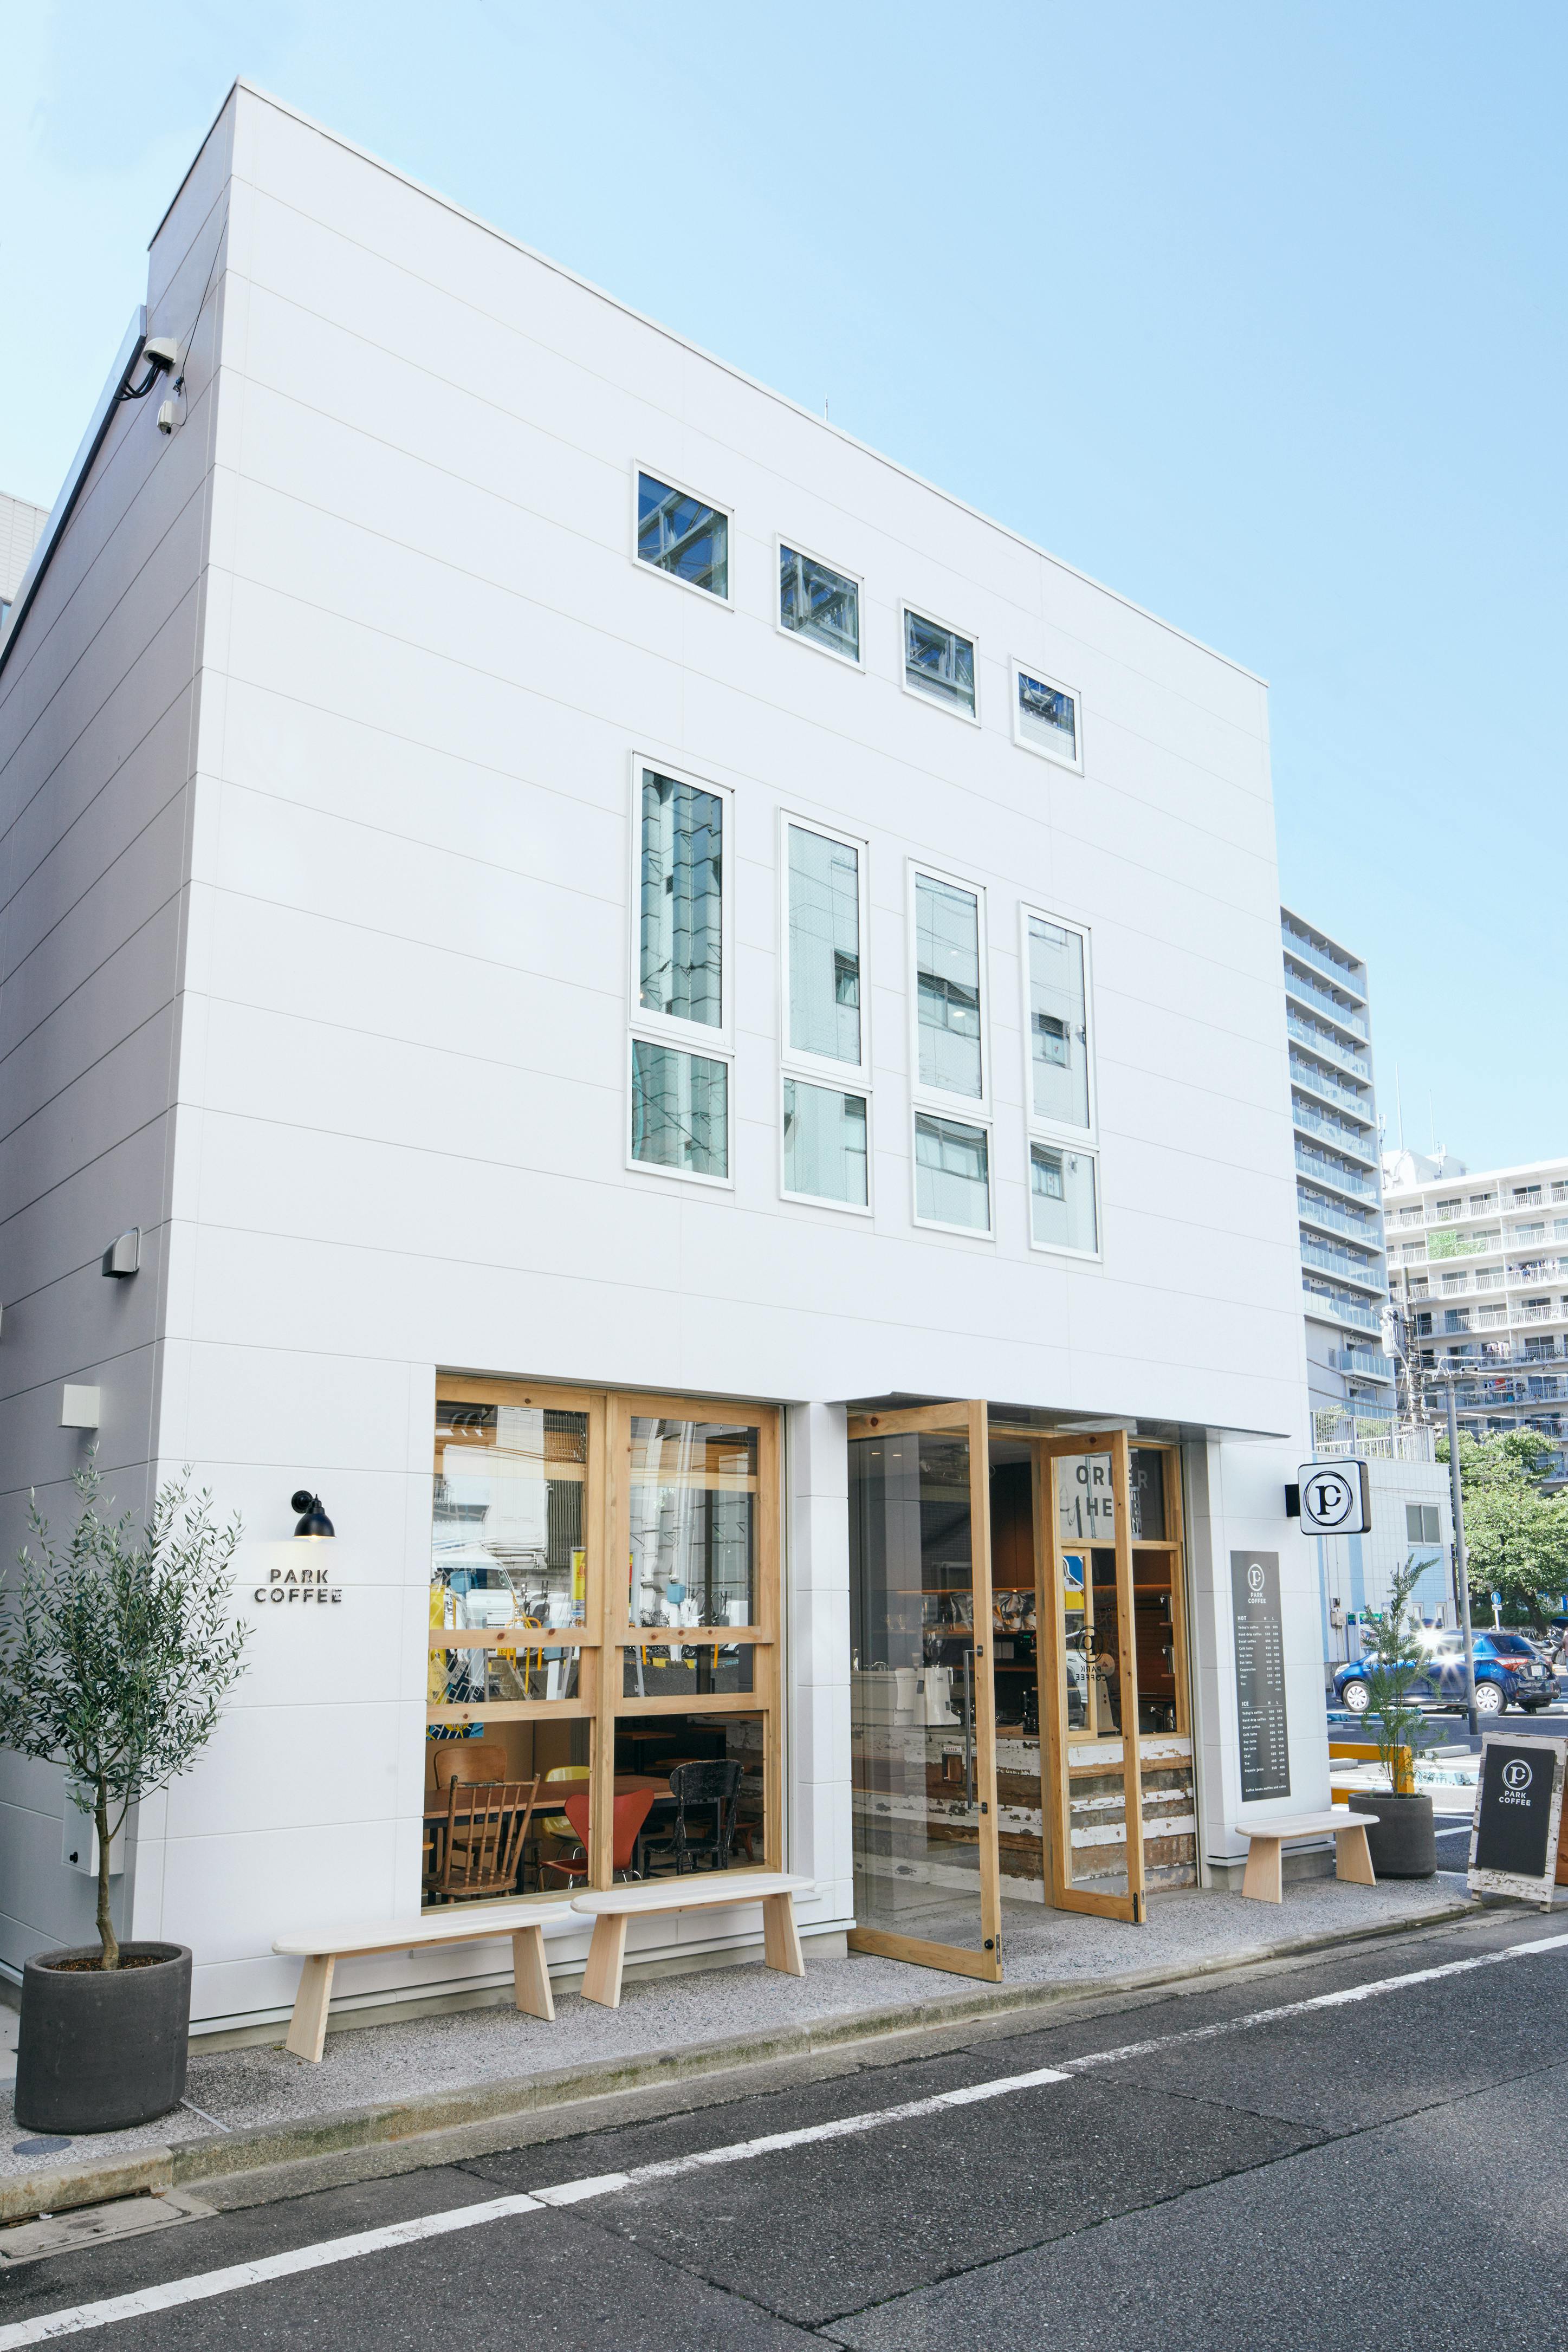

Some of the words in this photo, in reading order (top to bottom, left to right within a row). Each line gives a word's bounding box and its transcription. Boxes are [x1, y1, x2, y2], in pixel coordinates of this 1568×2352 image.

[269, 1569, 328, 1583] PARK
[254, 1588, 342, 1603] COFFEE
[1499, 1797, 1531, 1806] COFFEE
